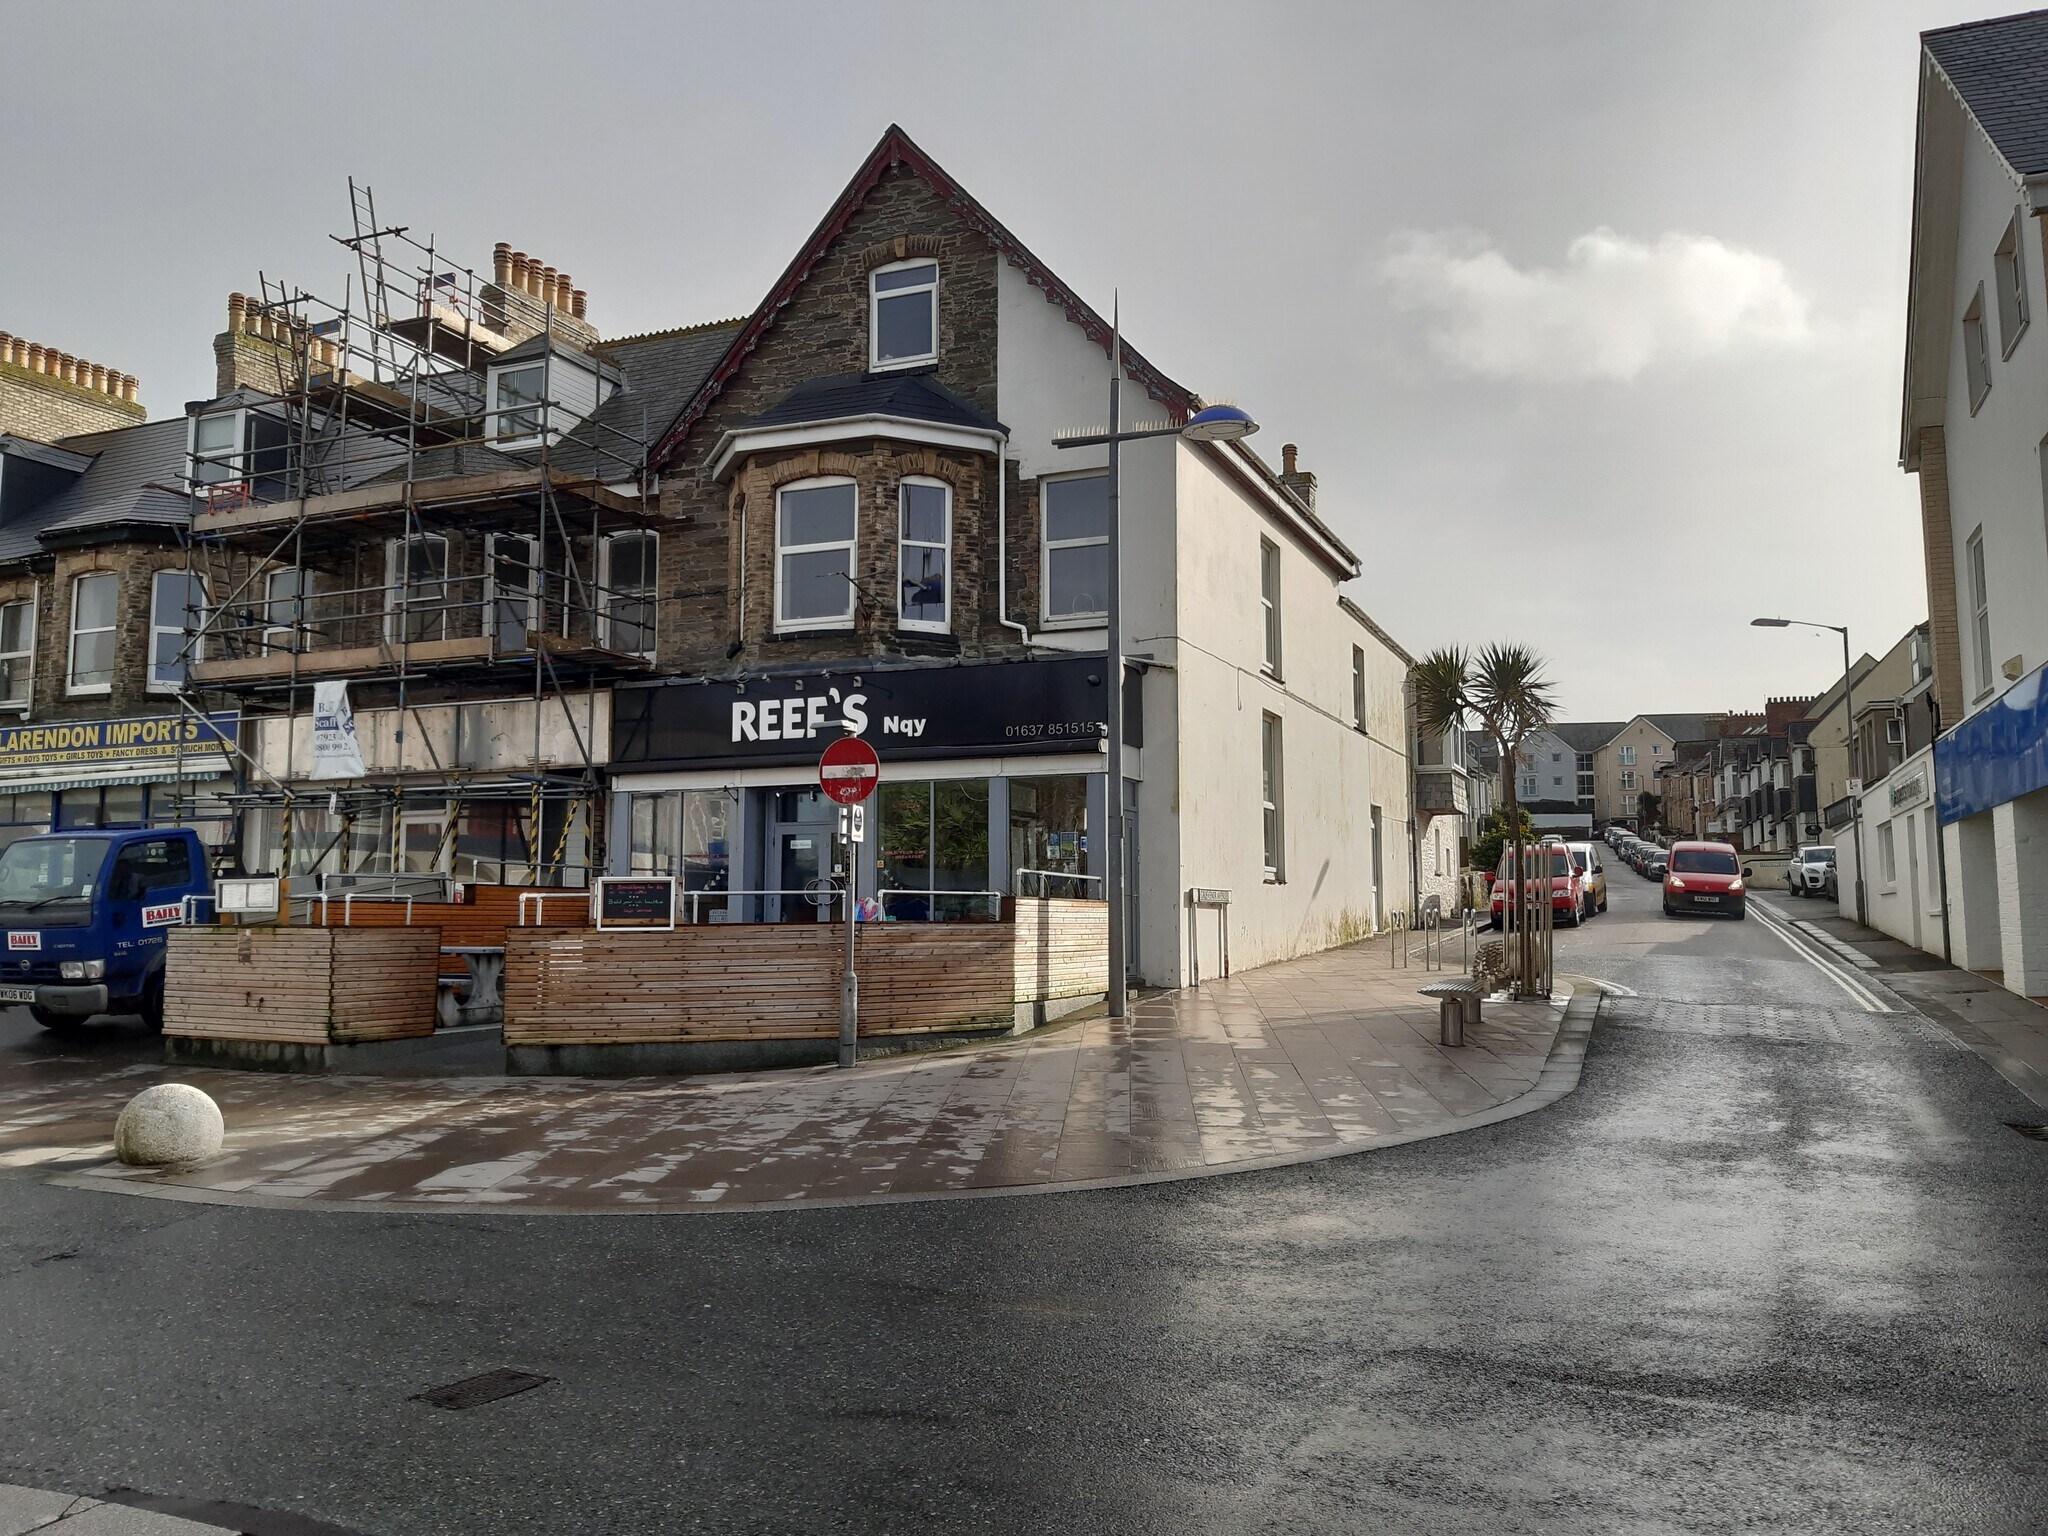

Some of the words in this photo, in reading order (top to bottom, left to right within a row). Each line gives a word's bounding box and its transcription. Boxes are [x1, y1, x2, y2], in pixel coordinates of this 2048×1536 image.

[732, 687, 868, 742] REEF'S
[883, 715, 927, 737] Nqy
[105, 718, 198, 745] IMPORTS
[1005, 724, 1044, 737] 01637
[1047, 721, 1095, 735] 851515
[23, 754, 40, 763] BOYS
[42, 753, 58, 762] TOYS
[66, 751, 85, 761] GIRLS
[87, 750, 104, 759] TOYS
[112, 748, 134, 757] FANCY
[136, 746, 158, 756] DRESS
[161, 746, 167, 754] &
[205, 740, 225, 750] MOR
[146, 906, 181, 921] BAILY
[10, 935, 37, 945] BAILY
[138, 936, 163, 946] 01726
[19, 990, 33, 1001] WDG
